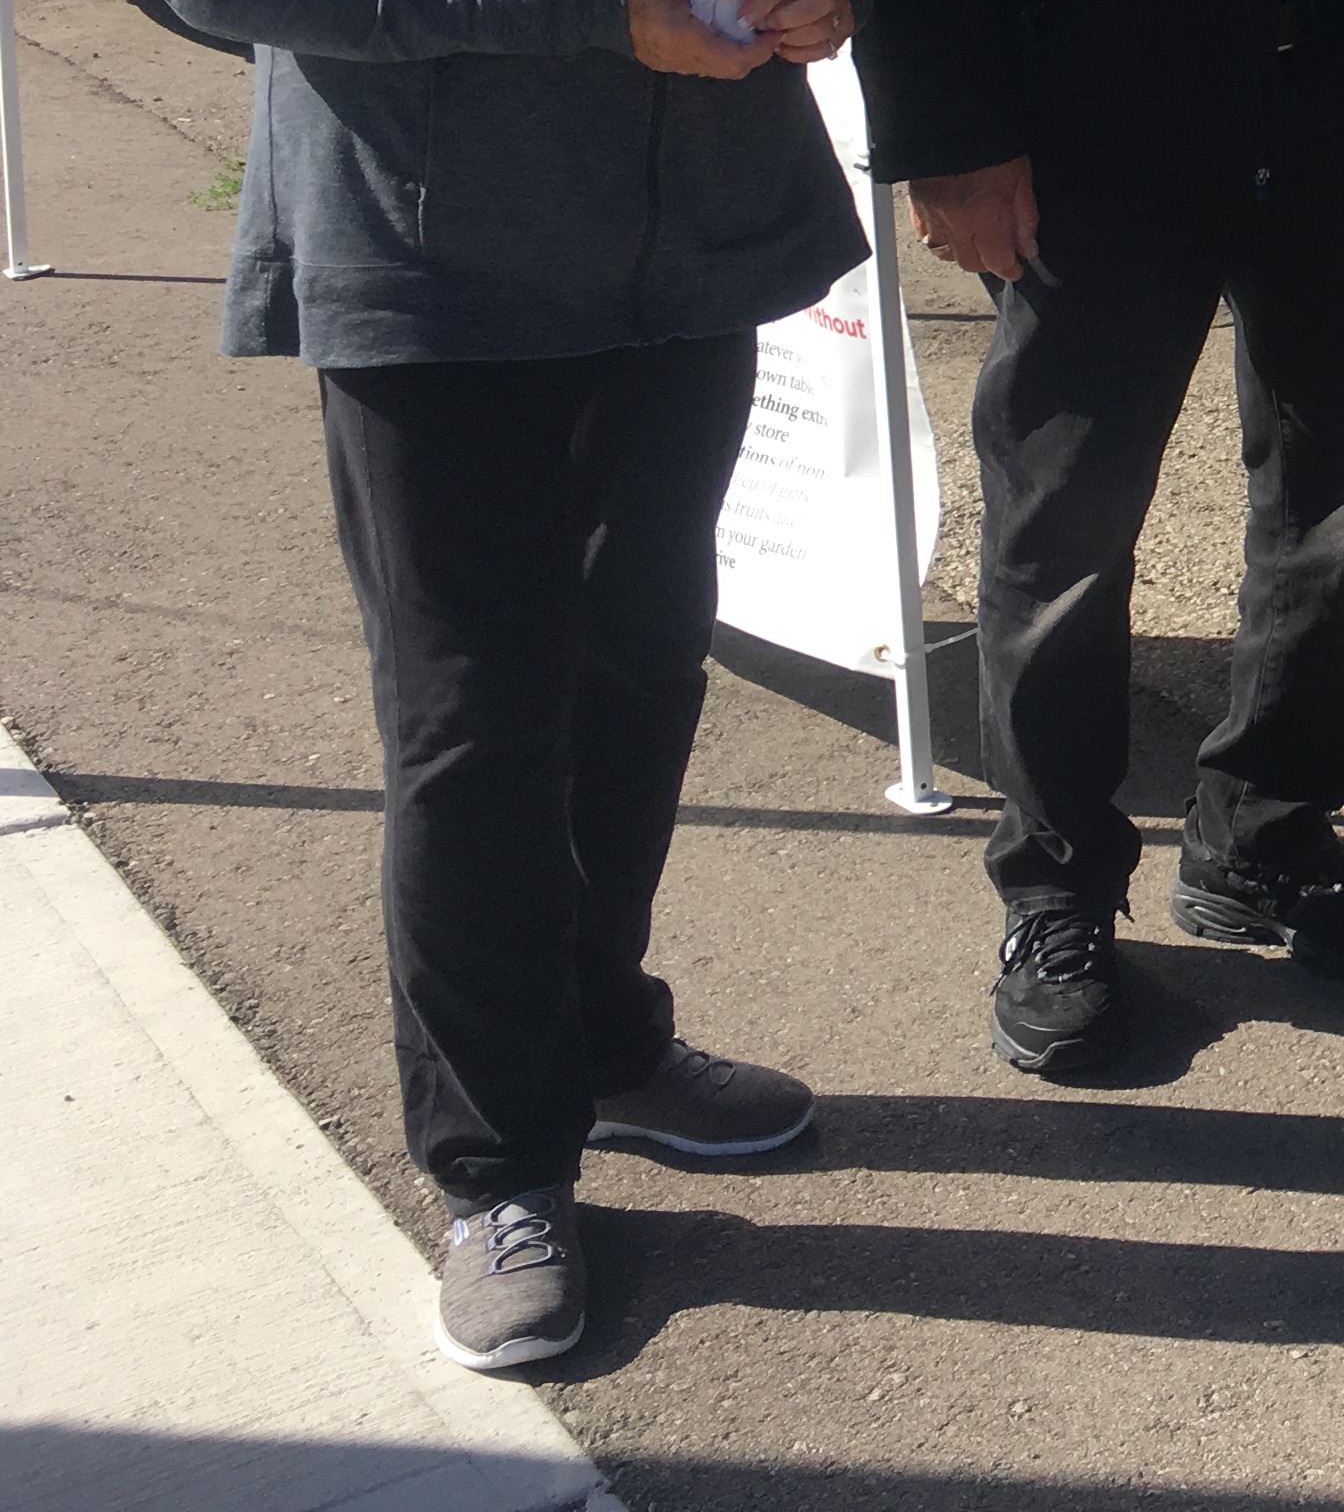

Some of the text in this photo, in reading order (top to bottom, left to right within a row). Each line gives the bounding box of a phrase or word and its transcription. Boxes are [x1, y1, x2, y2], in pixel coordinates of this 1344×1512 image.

[757, 340, 794, 361] atever
[752, 394, 800, 422] ething
[754, 422, 790, 443] store
[739, 445, 776, 466] tions
[779, 457, 799, 471] of
[727, 529, 759, 546] your
[758, 540, 807, 561] garden
